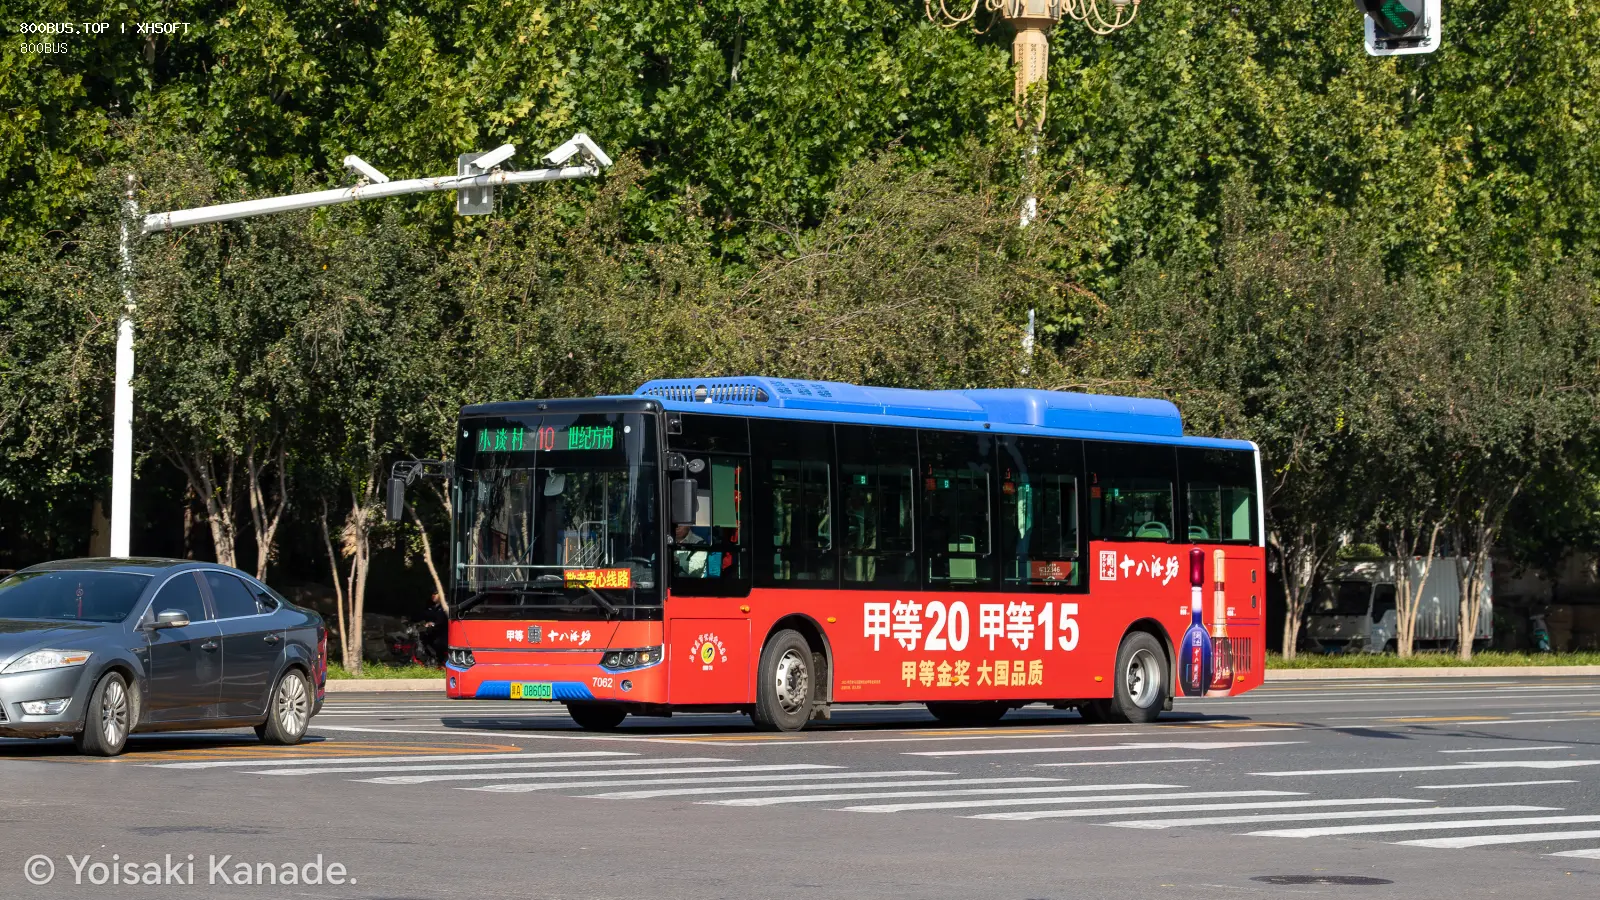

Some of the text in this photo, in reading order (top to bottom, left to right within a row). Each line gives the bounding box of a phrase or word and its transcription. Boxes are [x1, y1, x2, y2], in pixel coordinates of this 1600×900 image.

[479, 425, 614, 452] 小谈村 10 世纪方舟
[506, 629, 525, 643] 甲等
[863, 599, 1080, 652] 甲等20 甲等15
[592, 677, 613, 689] 7062
[901, 658, 1044, 688] 甲等金奖 大国品质
